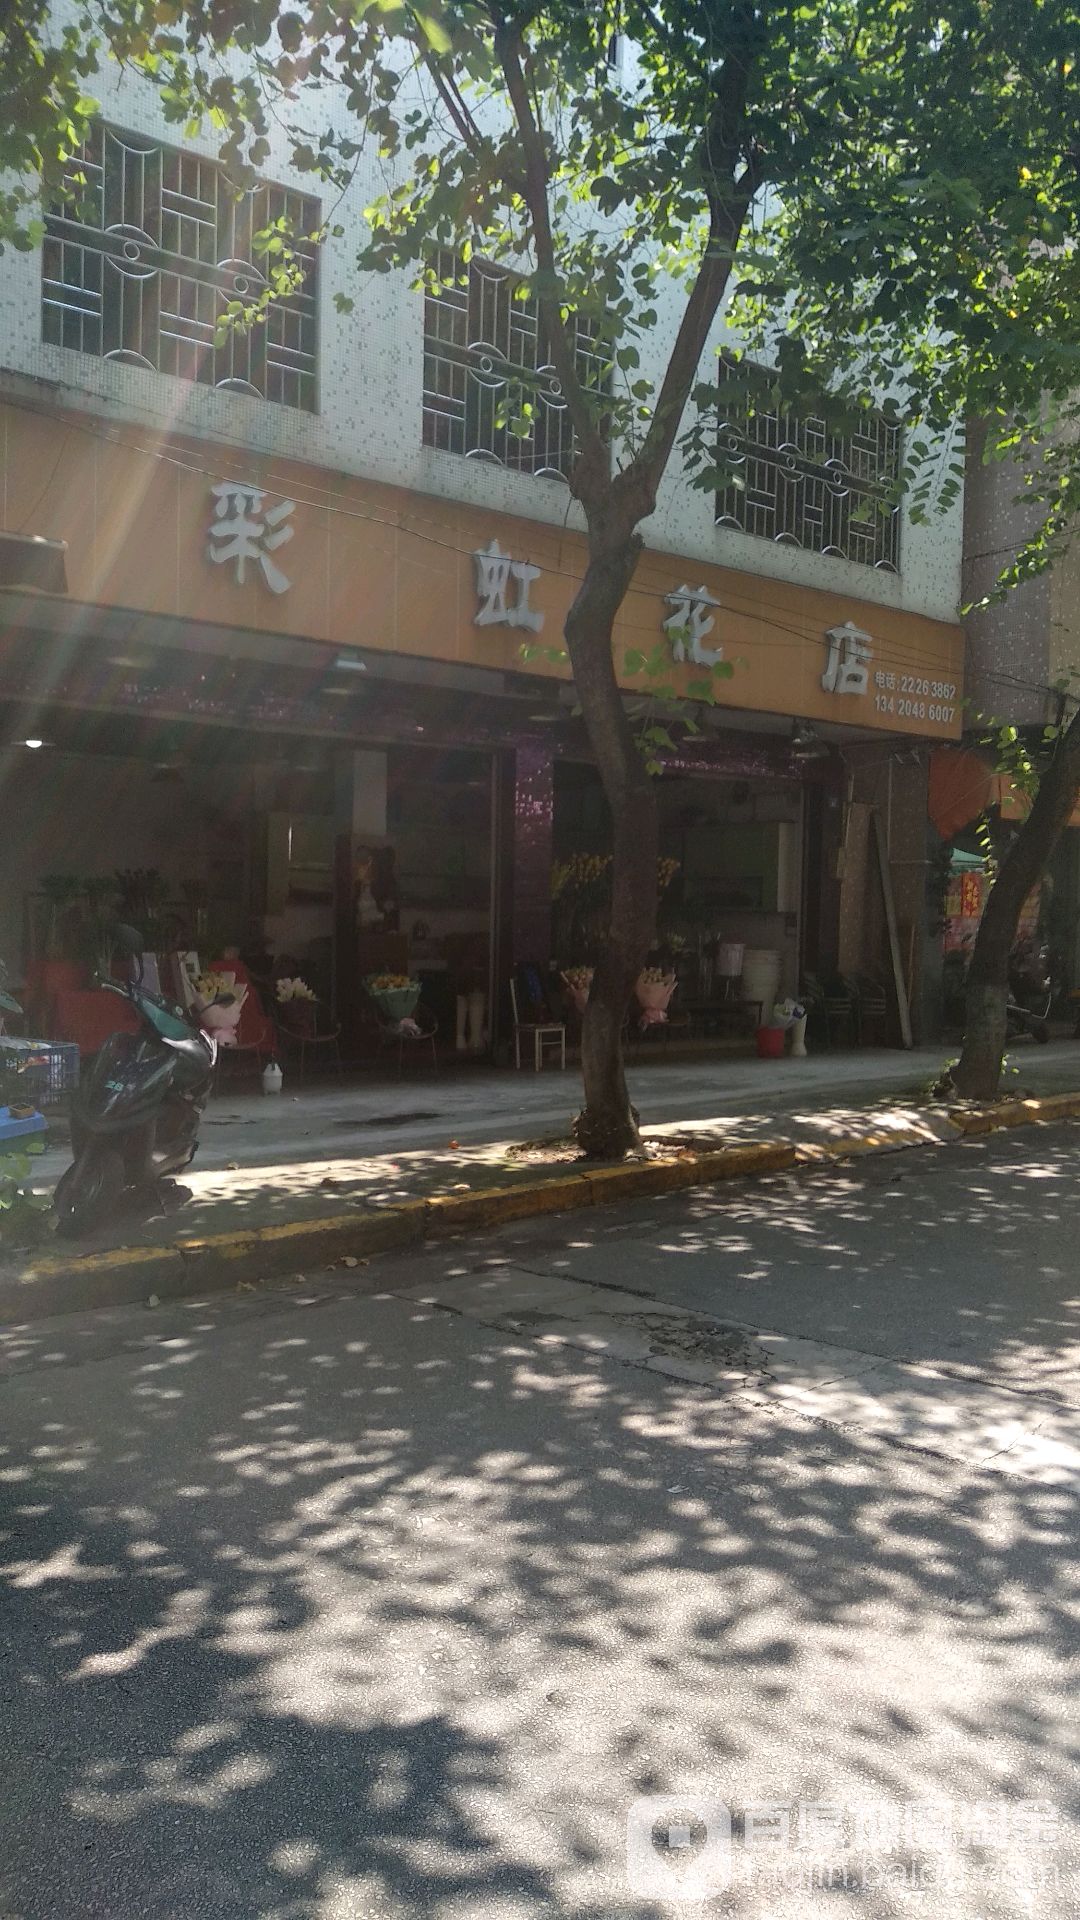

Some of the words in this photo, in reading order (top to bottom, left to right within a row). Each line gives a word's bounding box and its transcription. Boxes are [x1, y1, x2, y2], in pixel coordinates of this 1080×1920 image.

[207, 481, 873, 696] 彩虹花店
[875, 695, 894, 713] 134
[898, 699, 926, 719] 2048
[929, 704, 955, 723] 6007
